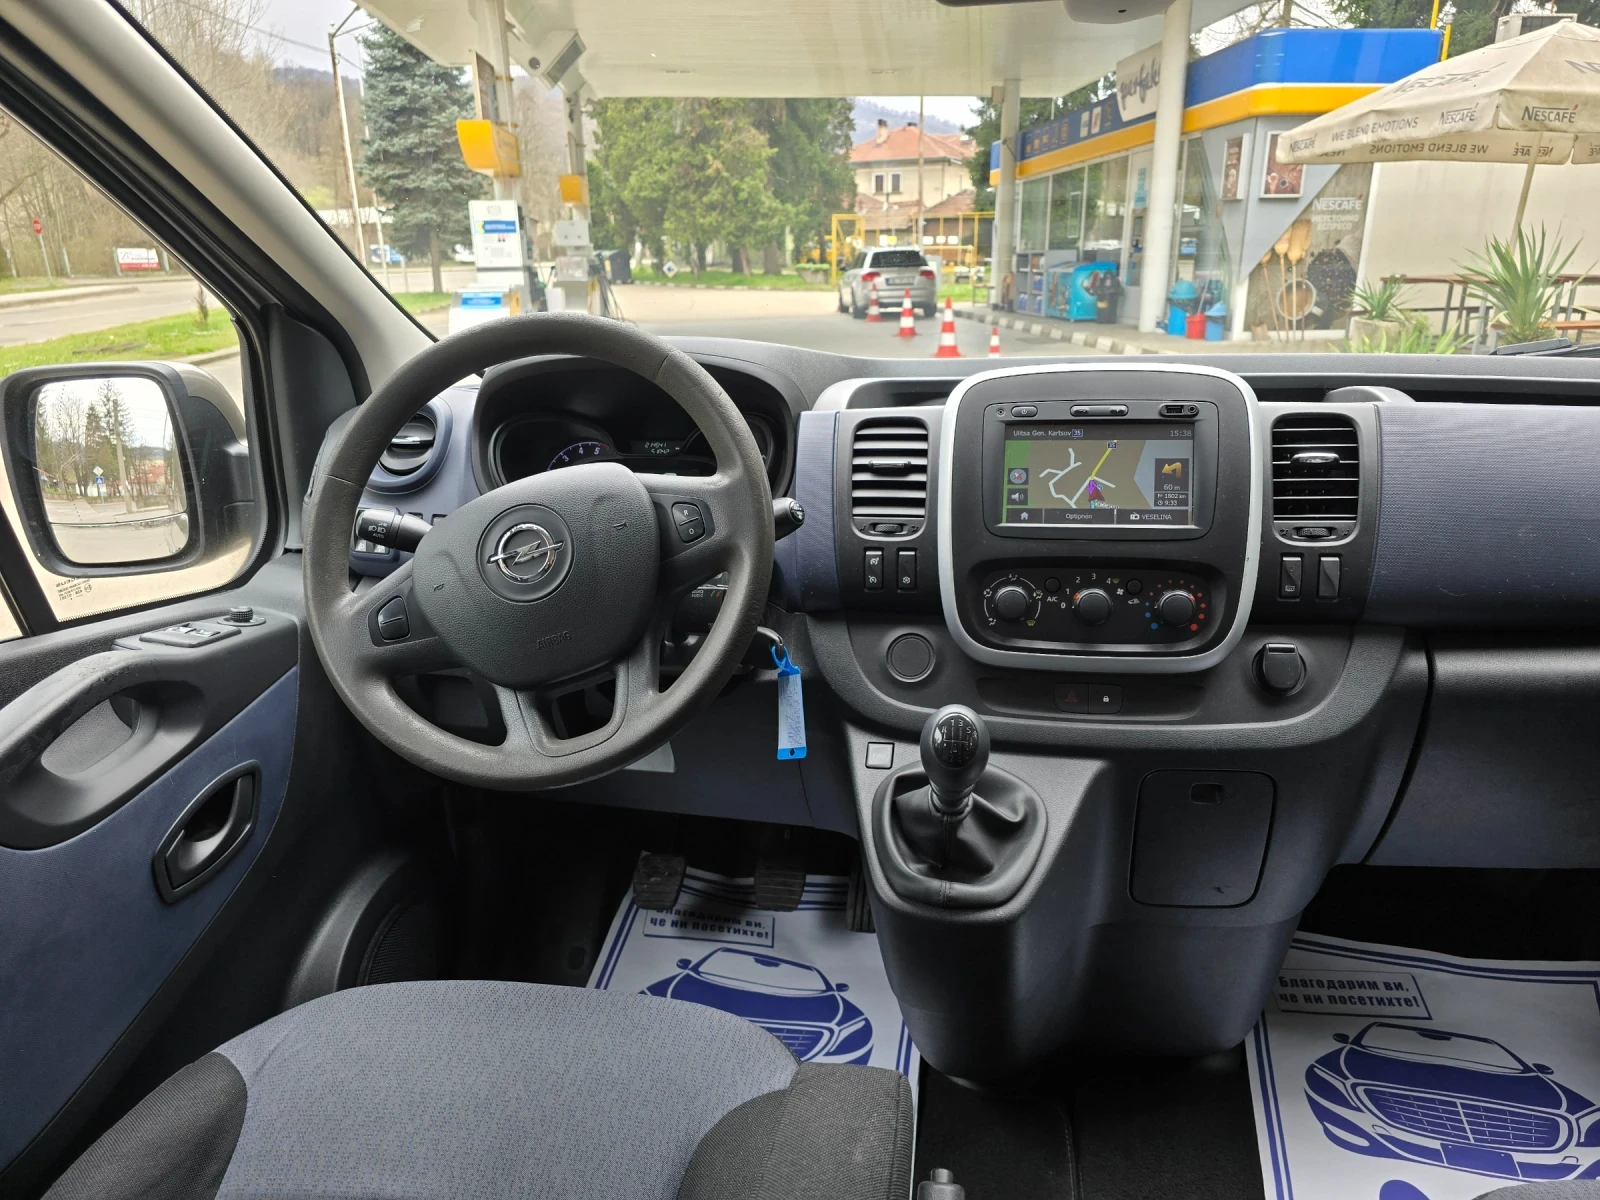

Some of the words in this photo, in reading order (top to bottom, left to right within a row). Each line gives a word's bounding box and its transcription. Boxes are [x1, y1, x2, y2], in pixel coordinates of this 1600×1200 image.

[1120, 57, 1161, 111] perfek
[1521, 104, 1579, 124] NESCAFÉ
[1331, 131, 1345, 142] WE
[1346, 123, 1370, 140] BLEND
[1371, 116, 1419, 133] EMOTIONS
[1013, 429, 1031, 437] Ulitsa
[1031, 429, 1047, 437] Gen.
[1048, 429, 1072, 437] Kartsov
[578, 447, 584, 455] 4
[594, 447, 600, 455] 5
[537, 630, 572, 650] AIRBAG
[958, 719, 964, 727] 3
[650, 917, 667, 927] че
[670, 919, 688, 929] ни
[691, 922, 769, 939] посетихте!
[1278, 976, 1380, 991] Благодарим
[1383, 981, 1410, 992] ви,
[1279, 992, 1299, 1003] че
[1303, 993, 1325, 1004] ни
[1327, 995, 1421, 1008] посетихте!
